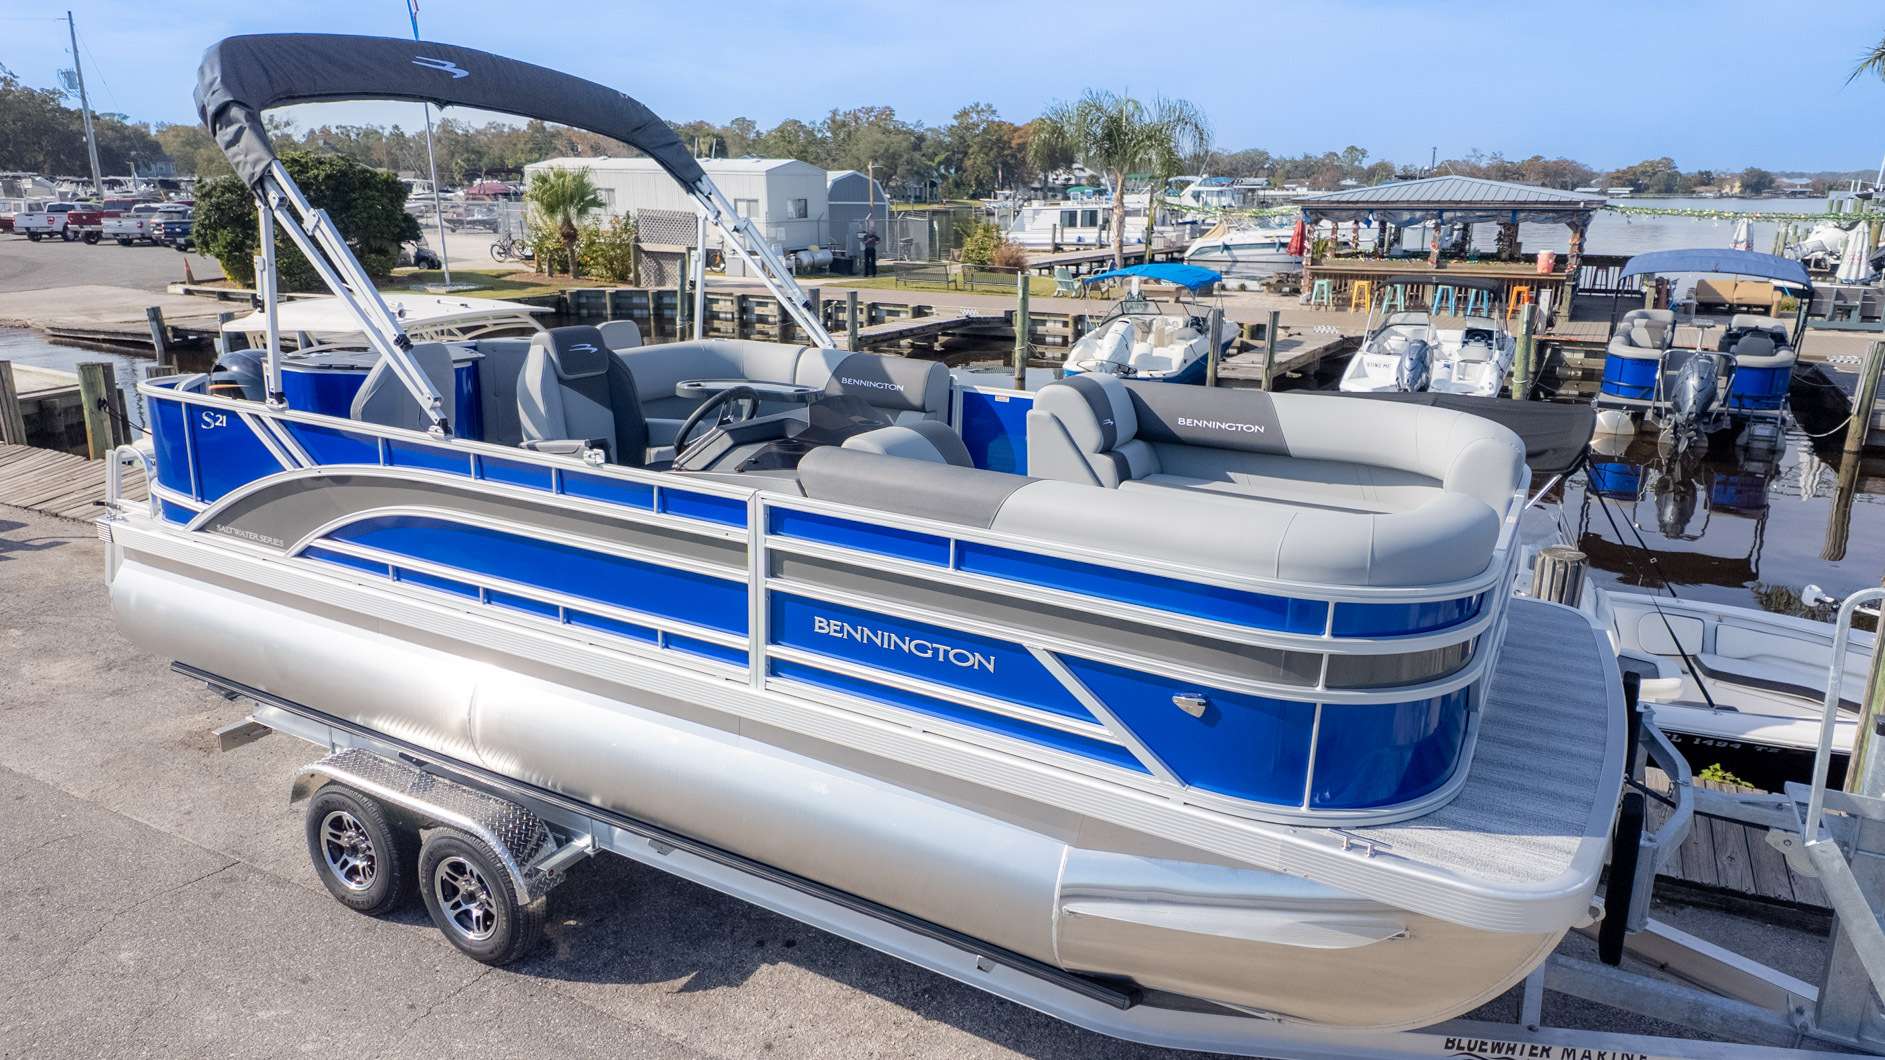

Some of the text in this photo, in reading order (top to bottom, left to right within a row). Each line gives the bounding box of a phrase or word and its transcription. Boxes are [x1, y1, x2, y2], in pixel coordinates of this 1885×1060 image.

[841, 377, 904, 392] BENNINGTON
[1177, 417, 1265, 433] BENNINGTON
[216, 524, 284, 547] SALTWATER SERIES
[813, 616, 996, 674] BENNINGTON
[1693, 737, 1742, 750] 1494
[1443, 1037, 1552, 1059] BLUEWATER
